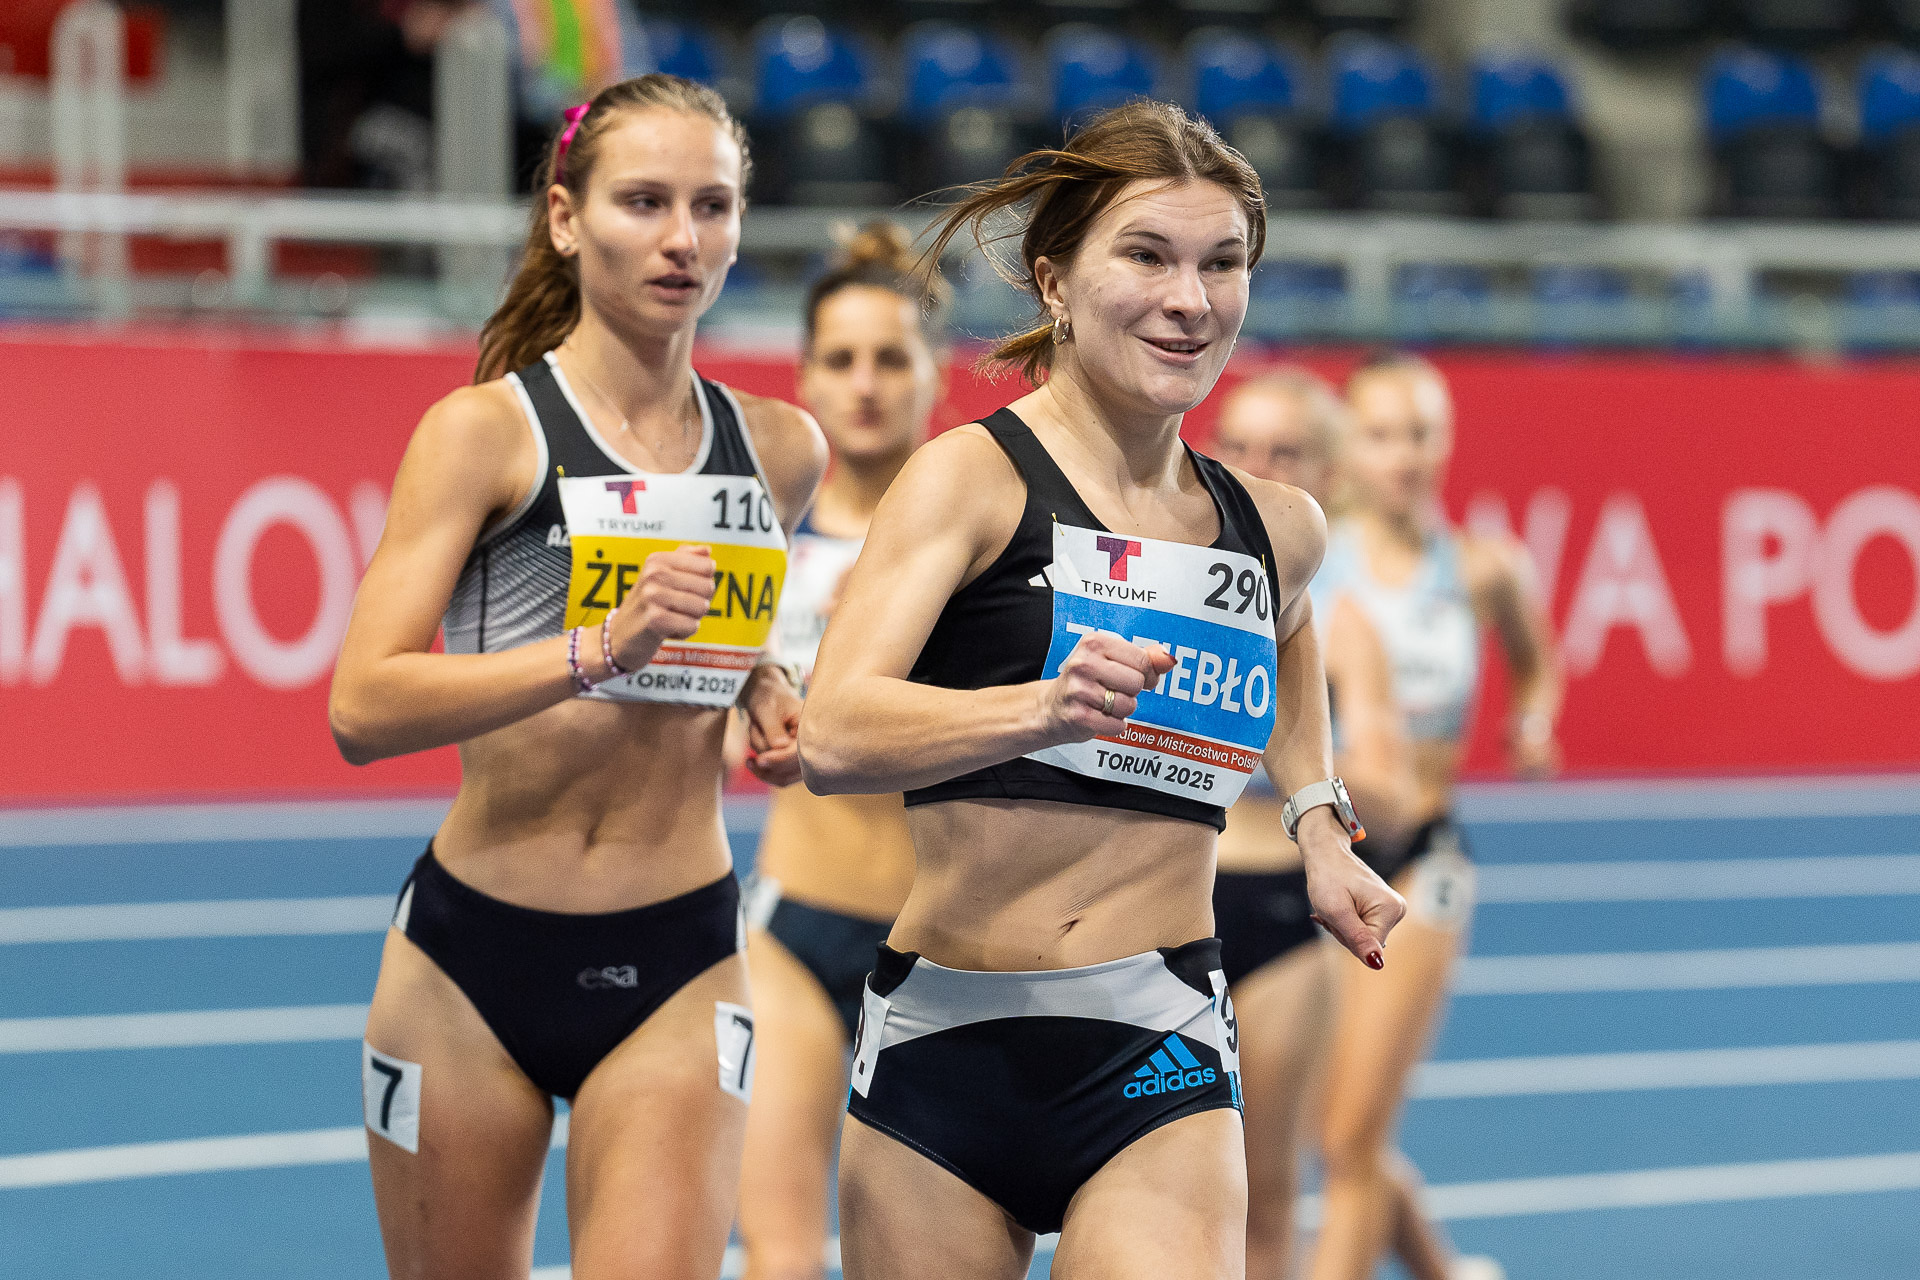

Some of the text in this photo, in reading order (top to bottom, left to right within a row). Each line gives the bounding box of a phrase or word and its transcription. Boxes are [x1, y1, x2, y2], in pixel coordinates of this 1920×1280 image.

[598, 518, 668, 532] TRYUMF
[712, 488, 772, 533] 110
[1081, 579, 1157, 603] TRYUMF
[1203, 562, 1268, 621] 290
[1096, 749, 1216, 792] TORUŃ 2025
[1116, 728, 1259, 770] alowe Mistrzostwa Polski
[1220, 985, 1239, 1054] 9
[733, 1013, 754, 1092] 7
[370, 1055, 404, 1131] 7
[1123, 1065, 1217, 1099] adidas
